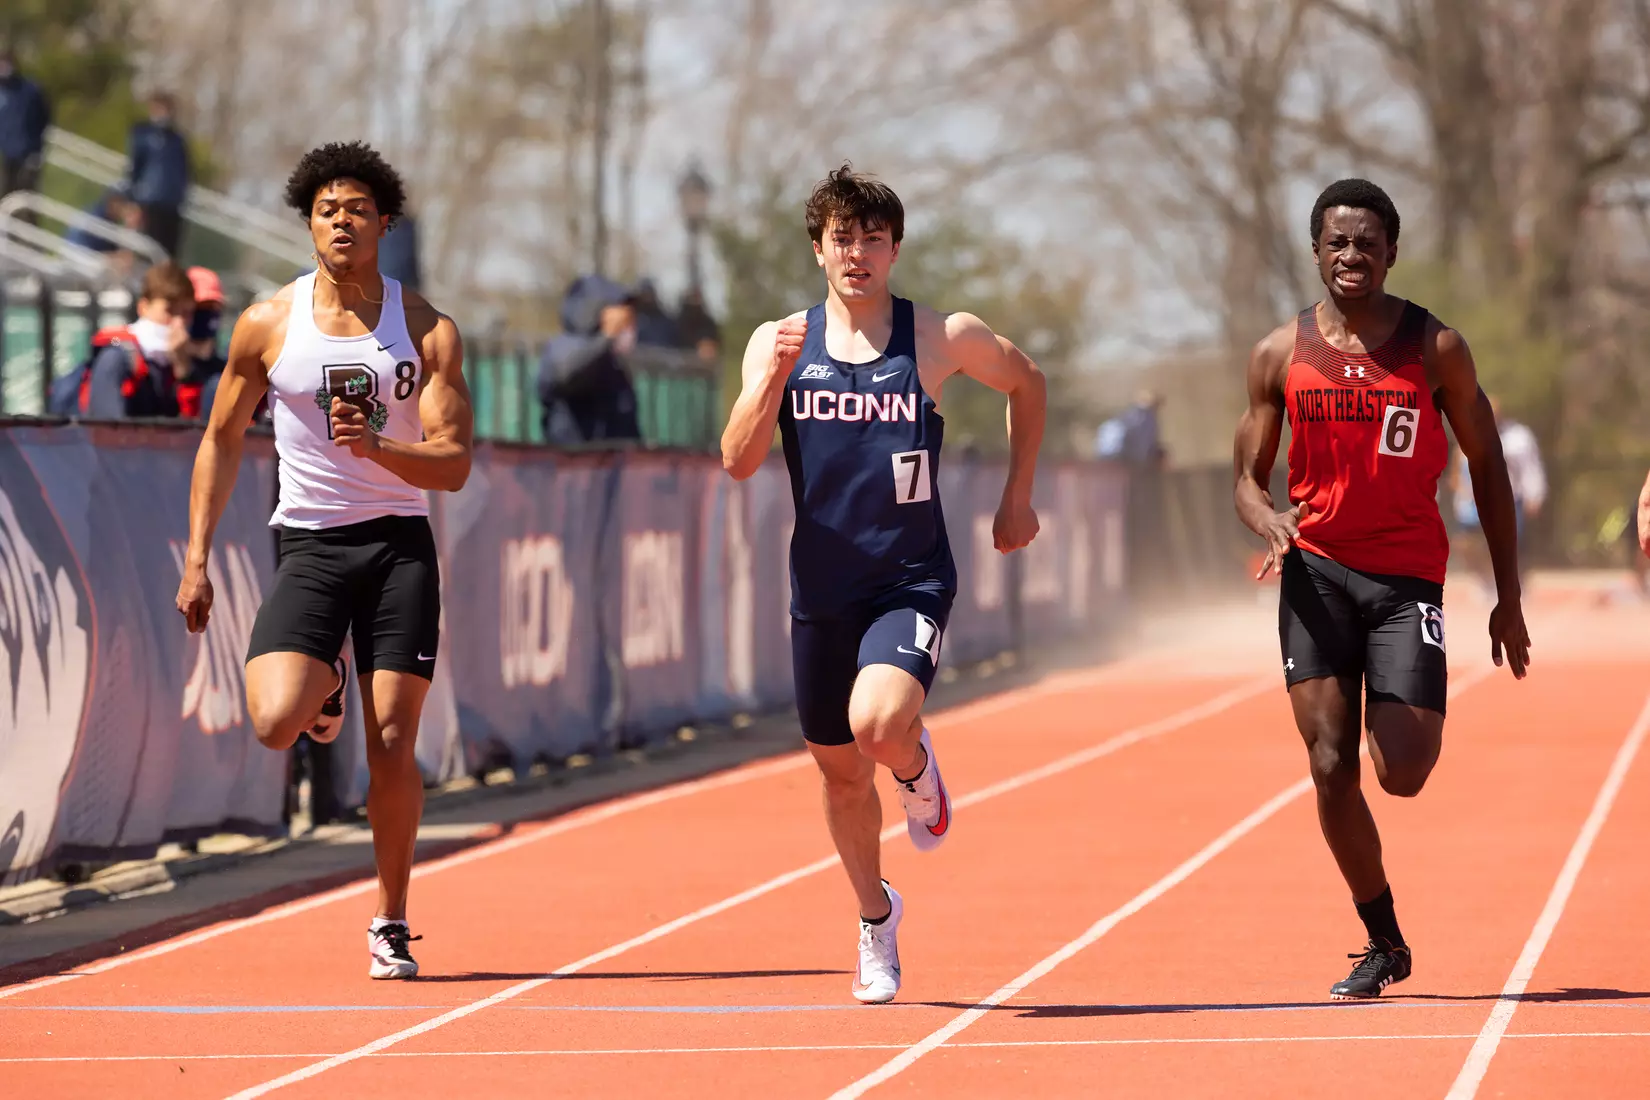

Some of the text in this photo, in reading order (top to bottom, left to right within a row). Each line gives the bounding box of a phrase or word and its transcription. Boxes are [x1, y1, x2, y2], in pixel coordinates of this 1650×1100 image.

[394, 361, 416, 401] 8
[801, 370, 834, 378] EAST
[805, 363, 829, 371] BIG
[791, 390, 917, 422] UCONN
[1386, 410, 1415, 453] 6
[900, 454, 922, 501] 7
[923, 617, 938, 652] 7
[1425, 605, 1443, 643] 6
